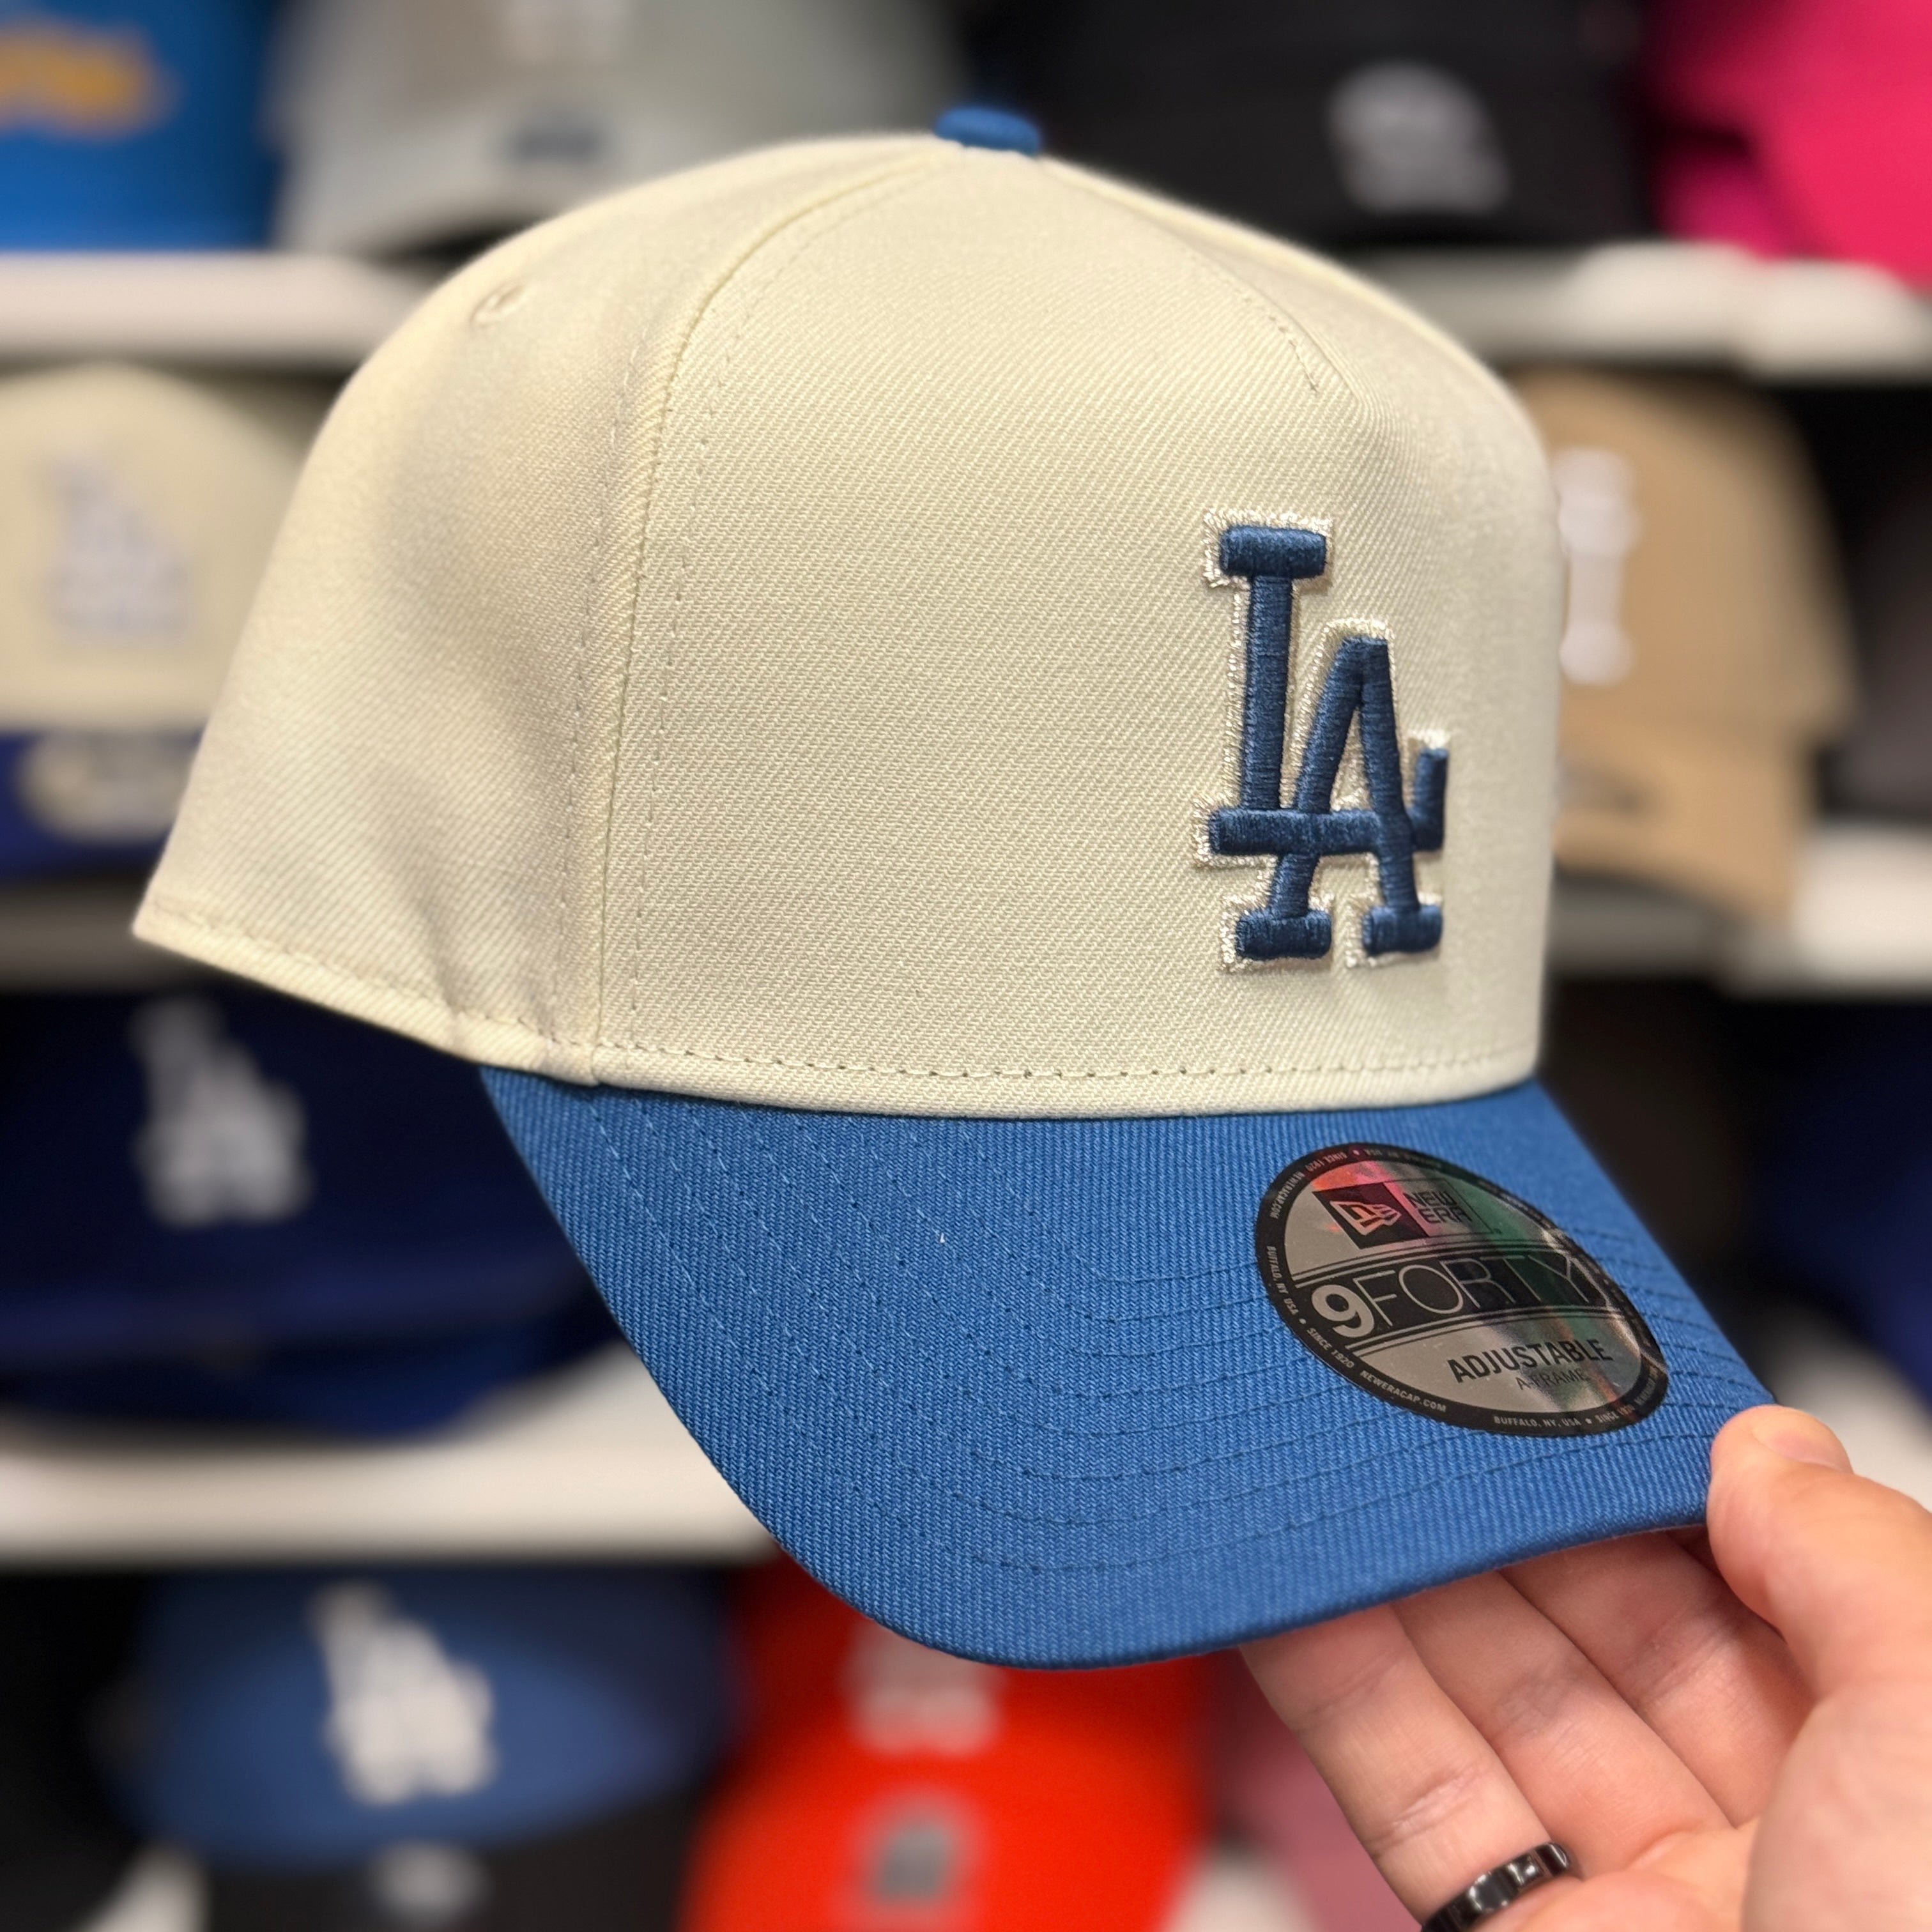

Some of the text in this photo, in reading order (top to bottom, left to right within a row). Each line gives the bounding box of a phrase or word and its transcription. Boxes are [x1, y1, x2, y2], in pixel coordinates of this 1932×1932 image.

[1201, 519, 1448, 963] LA
[1403, 1191, 1458, 1209] NEW
[1418, 1206, 1473, 1224] ERA
[1311, 1253, 1590, 1338] 9FORTY
[1284, 1298, 1300, 1315] USA
[1307, 1328, 1333, 1351] SINCE
[1331, 1349, 1355, 1368] 1920
[1360, 1370, 1447, 1413] NEWERACAP.COM
[1447, 1338, 1614, 1384] ADJUSTABLE
[1494, 1415, 1542, 1427] BUFFALO,
[1561, 1417, 1582, 1427] USA
